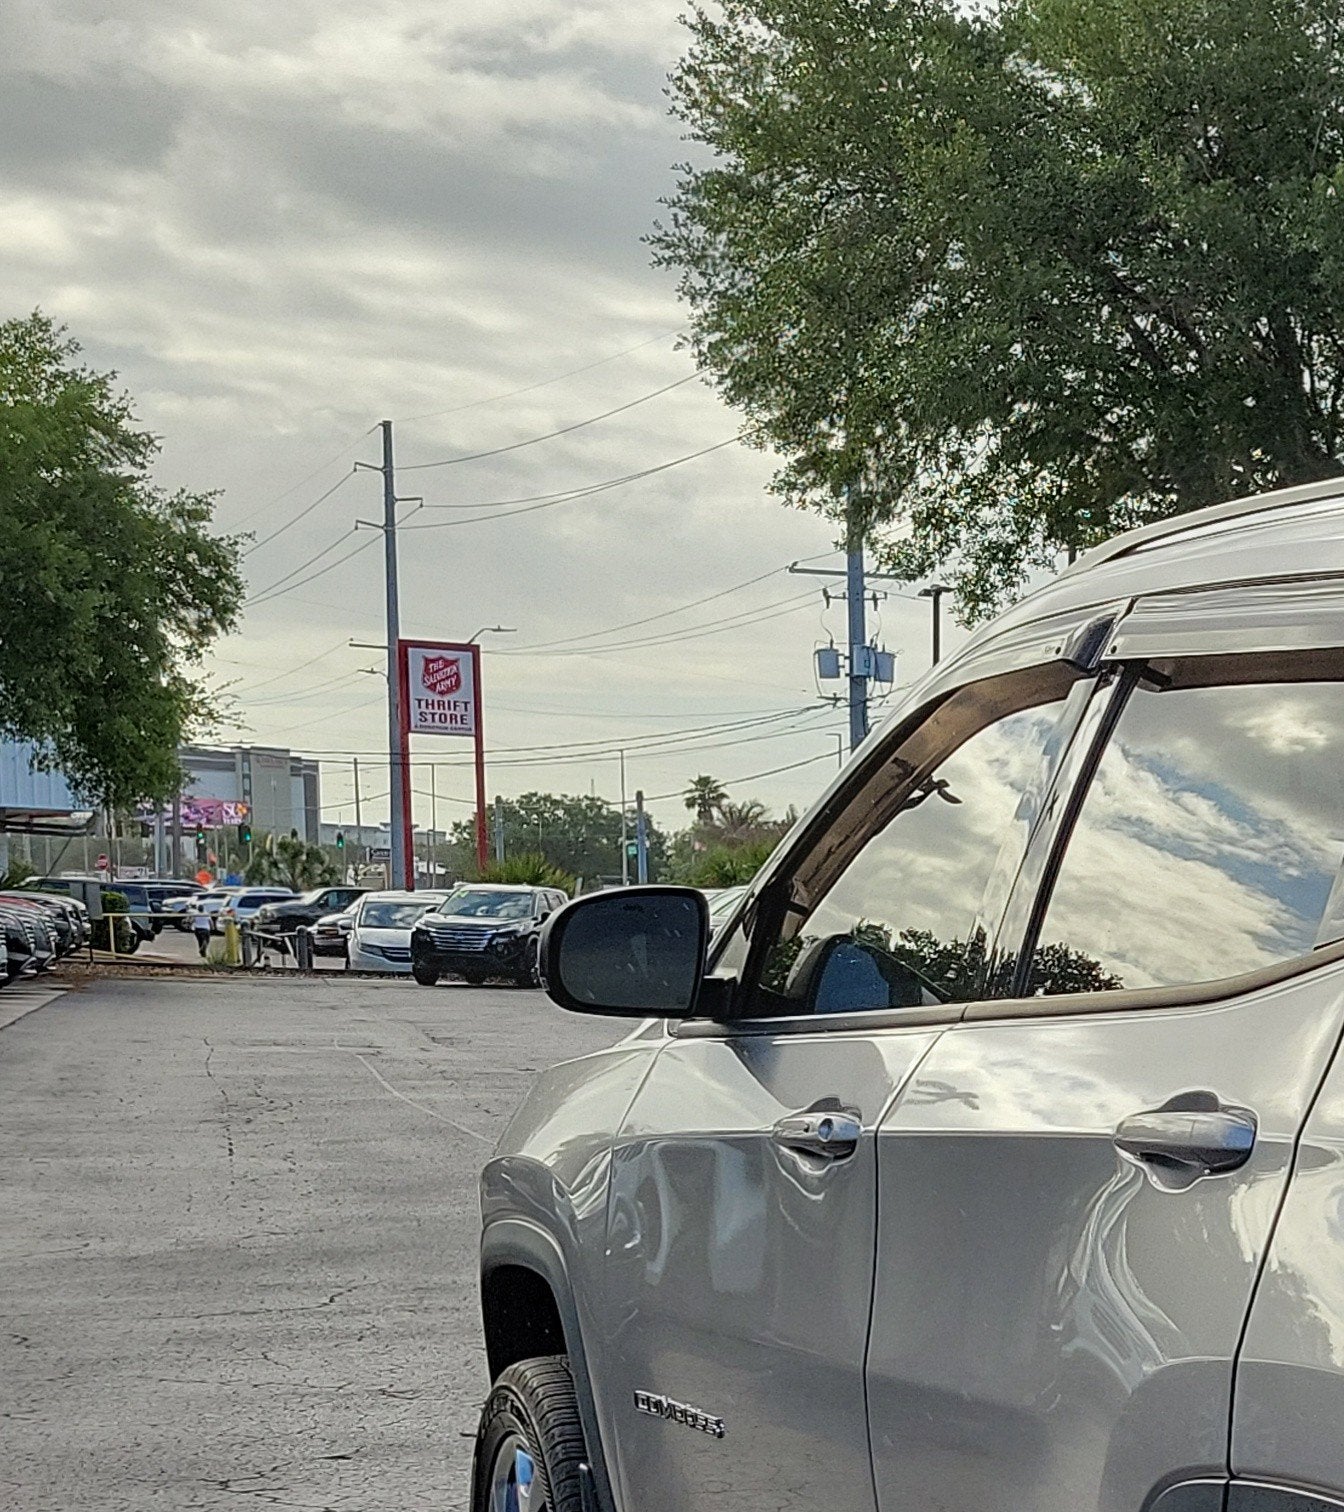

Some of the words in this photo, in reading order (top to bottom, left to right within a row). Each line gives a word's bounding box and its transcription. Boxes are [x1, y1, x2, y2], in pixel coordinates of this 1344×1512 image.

[435, 675, 457, 693] ARMY
[414, 698, 471, 713] THRIFT
[419, 711, 469, 726] STORE
